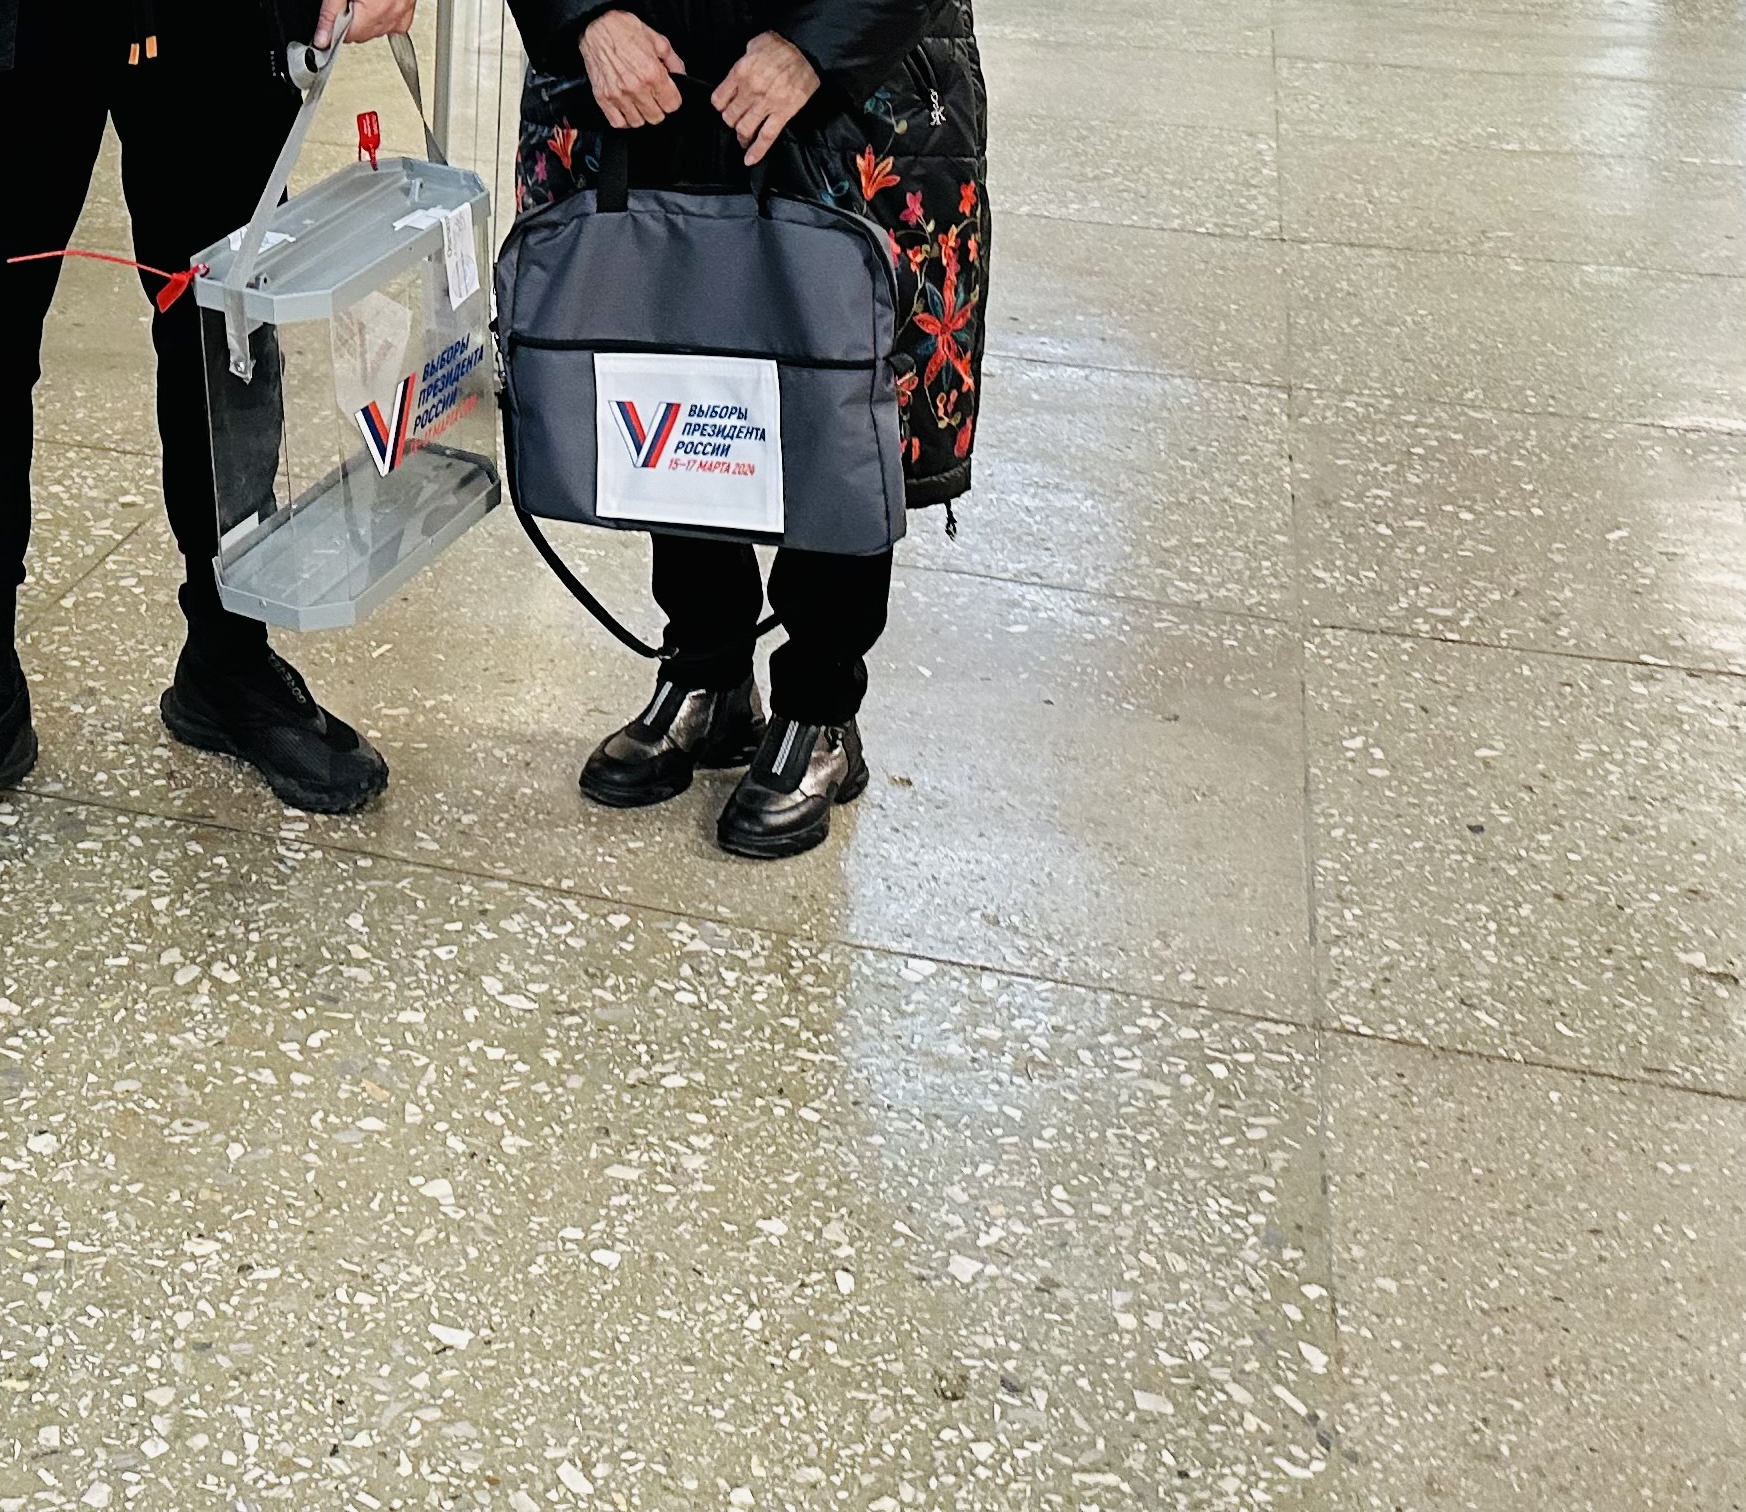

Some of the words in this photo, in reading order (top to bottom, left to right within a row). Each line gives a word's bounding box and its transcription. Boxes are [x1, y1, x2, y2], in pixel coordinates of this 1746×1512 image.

[422, 332, 470, 383] ВЫБОРЫ
[417, 344, 484, 409] ПРЕЗИДЕНТА
[413, 386, 458, 435] РОССИИ
[688, 404, 748, 421] ВЫБОРЫ
[682, 422, 766, 442] ПРЕЗИДЕНТА
[674, 441, 732, 457] РОССИИ
[696, 462, 730, 474] МАРТА
[732, 462, 755, 476] 2024
